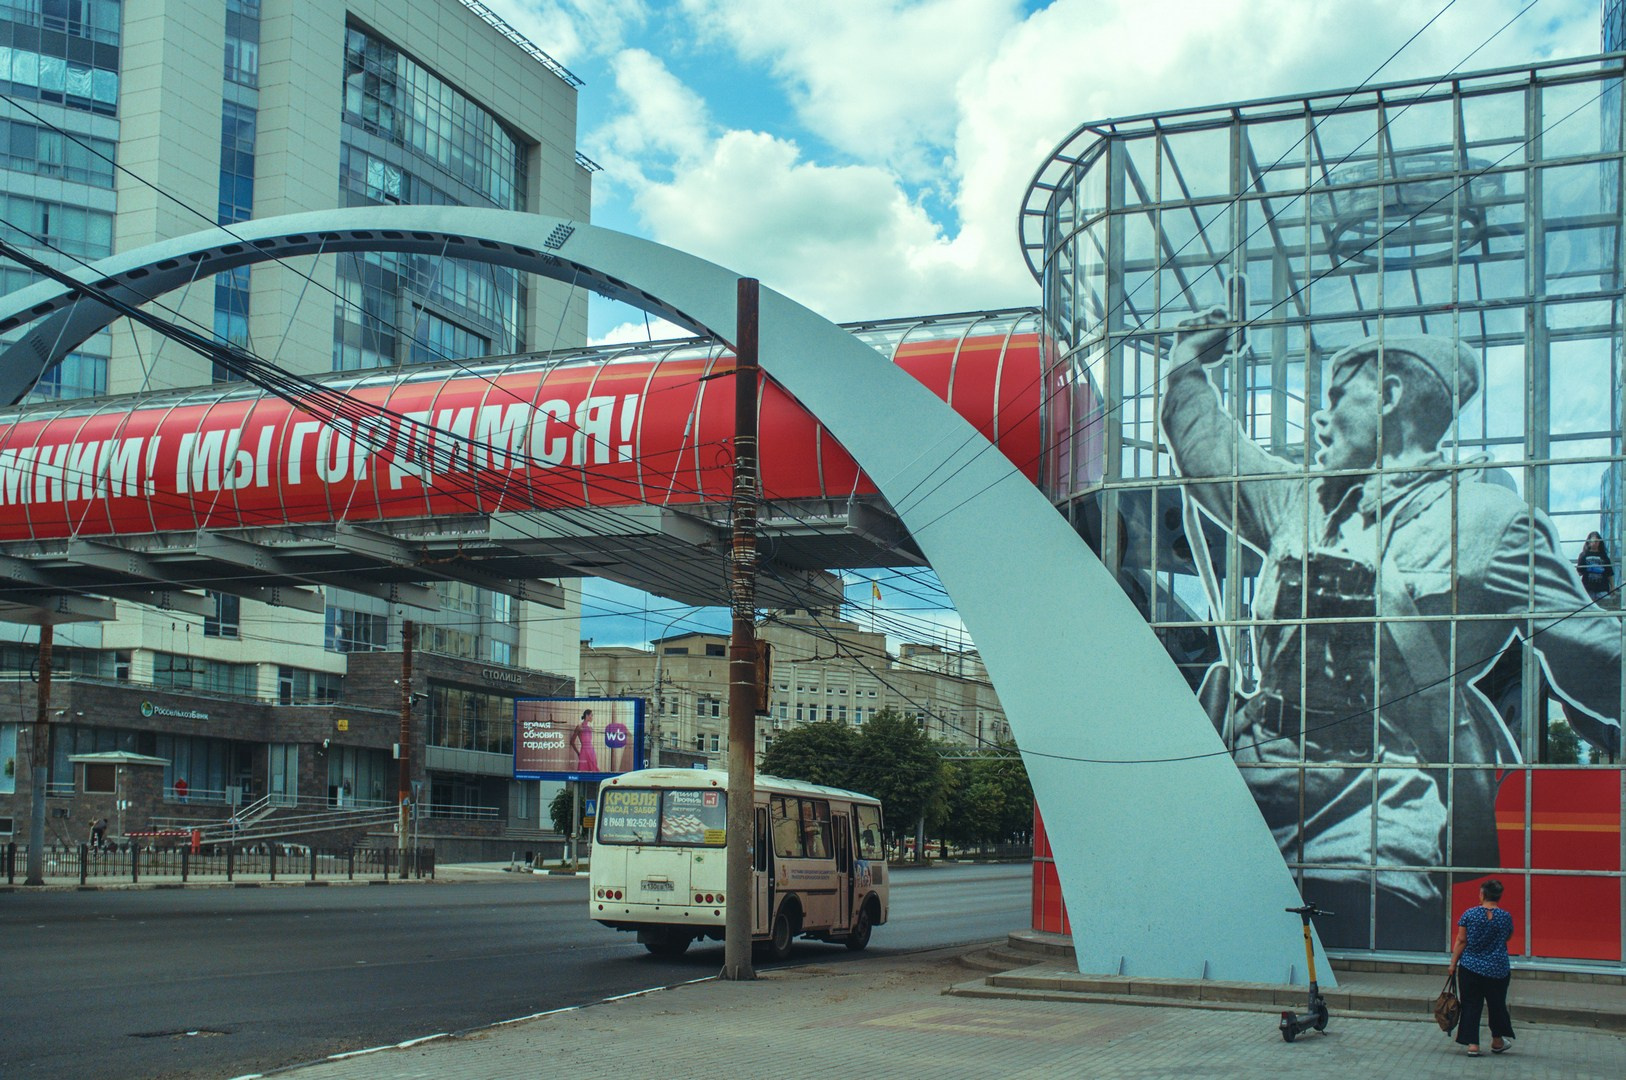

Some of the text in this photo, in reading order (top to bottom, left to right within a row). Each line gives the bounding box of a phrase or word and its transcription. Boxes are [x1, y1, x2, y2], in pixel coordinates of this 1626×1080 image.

[176, 425, 275, 493] МЫ
[288, 394, 639, 489] ГОРДИМСЯ!
[523, 721, 551, 731] время
[523, 729, 564, 740] обновить
[606, 729, 626, 741] wb
[523, 740, 565, 750] гардероб
[605, 792, 657, 806] КРОВЛЯ
[605, 805, 657, 814] ФАСАД ЗАБОР
[603, 817, 608, 826] 8
